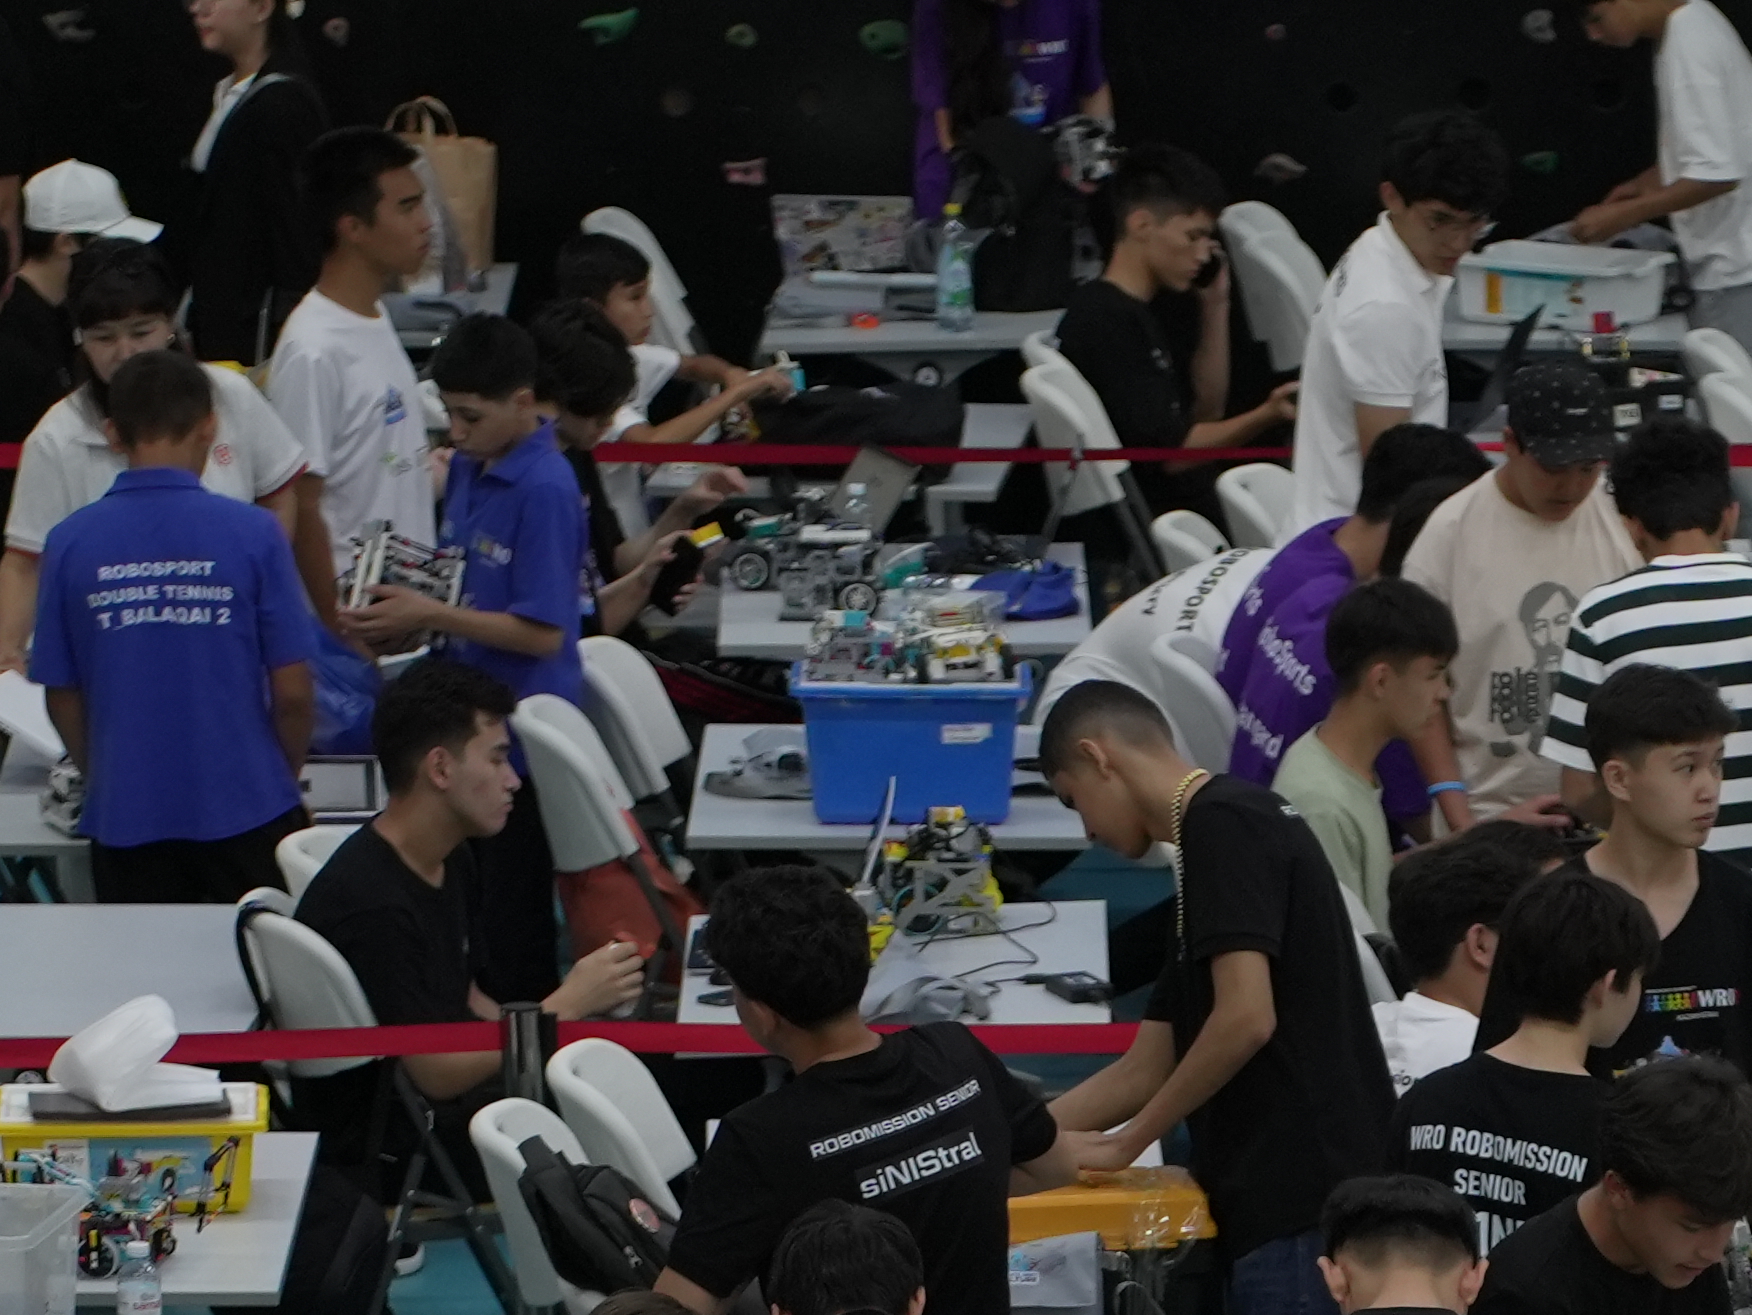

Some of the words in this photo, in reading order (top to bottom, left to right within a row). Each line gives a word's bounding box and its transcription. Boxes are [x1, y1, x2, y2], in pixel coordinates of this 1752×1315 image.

[96, 560, 217, 583] ROBOSPORT
[86, 585, 160, 608] DOUBLE
[162, 583, 235, 602] TENNIS
[215, 606, 233, 626] 2
[1696, 987, 1737, 1008] WRO
[810, 1101, 936, 1159] ROBOMISSION
[936, 1078, 983, 1112] SENIOR
[859, 1131, 983, 1200] siNIStral
[1410, 1124, 1444, 1150] WRO
[1450, 1127, 1589, 1184] ROBOMISSION
[1453, 1167, 1527, 1206] SENIOR
